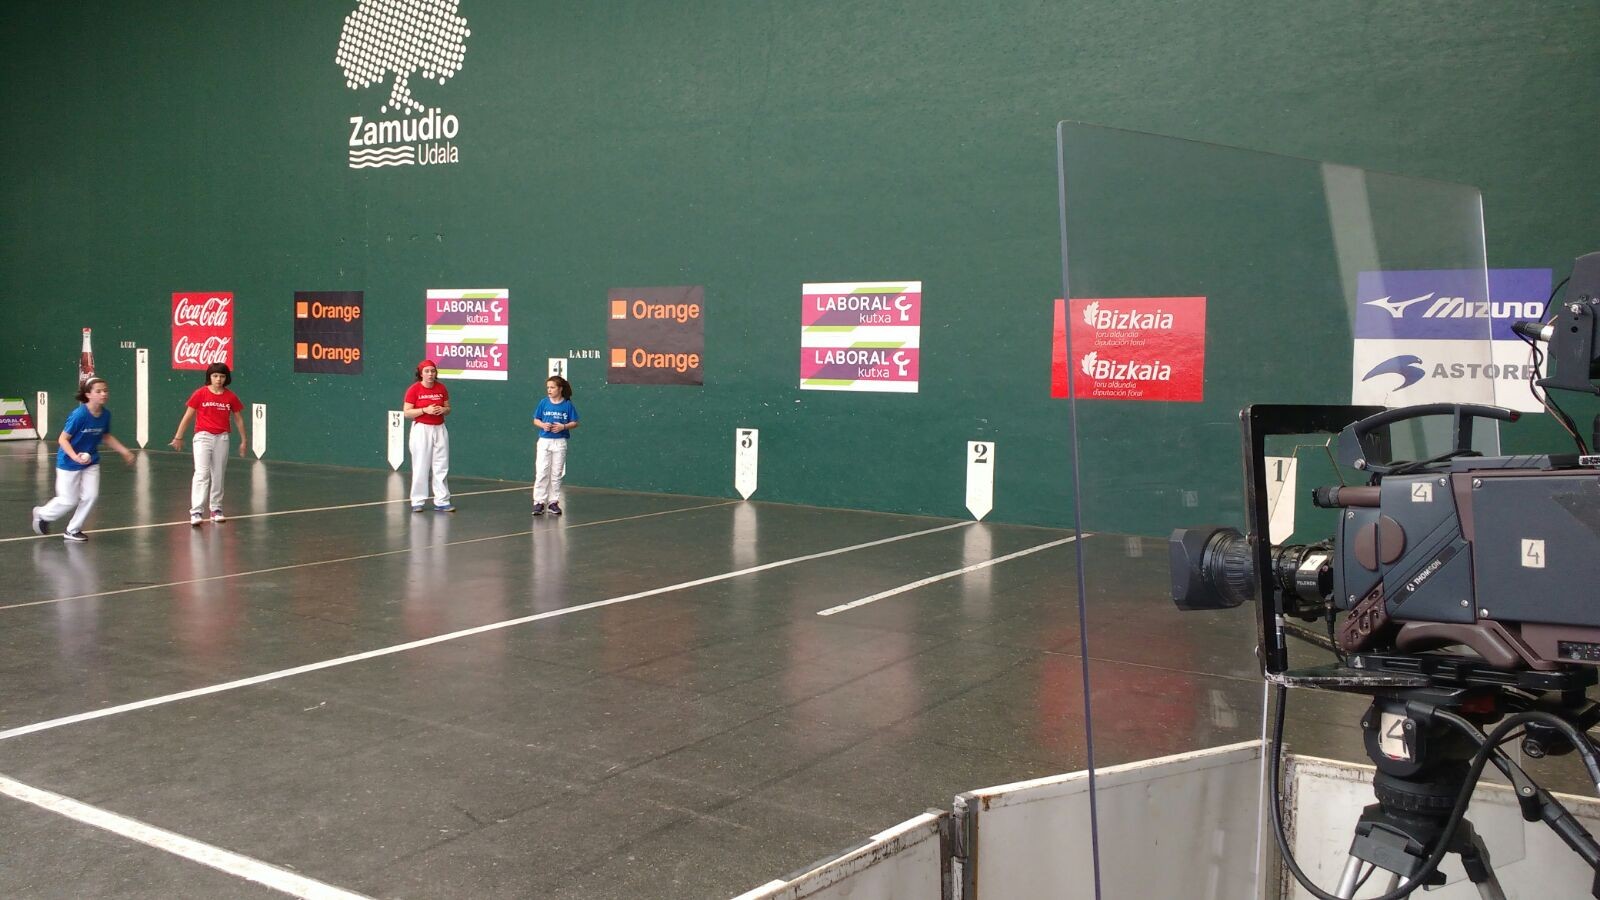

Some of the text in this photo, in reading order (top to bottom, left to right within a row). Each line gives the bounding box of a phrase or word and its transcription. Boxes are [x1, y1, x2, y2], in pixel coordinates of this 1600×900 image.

[349, 107, 459, 146] Zamudio
[418, 141, 459, 166] Udala
[174, 297, 231, 327] Coca-Cola
[312, 302, 360, 322] Orange
[436, 300, 488, 313] LABORAL
[632, 299, 700, 323] Orange
[816, 296, 891, 311] LABORAL
[466, 314, 489, 323] kutxa
[859, 312, 892, 324] kutxa
[1097, 309, 1174, 330] Bizkaia
[174, 335, 231, 365] Coca-Cola
[312, 343, 360, 364] Orange
[435, 345, 488, 358] LABORAL
[569, 349, 601, 359] LABUR
[815, 350, 889, 365] LABORAL
[465, 359, 488, 369] kutxa
[553, 360, 563, 376] 4
[632, 348, 699, 373] Orange
[857, 367, 890, 378] kutxa
[1095, 360, 1172, 381] Bizkaia
[1432, 363, 1537, 380] ASTORE
[39, 393, 46, 405] 8
[255, 405, 263, 420] 6
[392, 412, 400, 428] 5
[741, 431, 752, 449] 3
[974, 443, 988, 464] 2
[1273, 459, 1285, 482] 1
[1413, 483, 1430, 501] 4
[1527, 542, 1541, 564] 4
[1413, 559, 1442, 585] THOMSON
